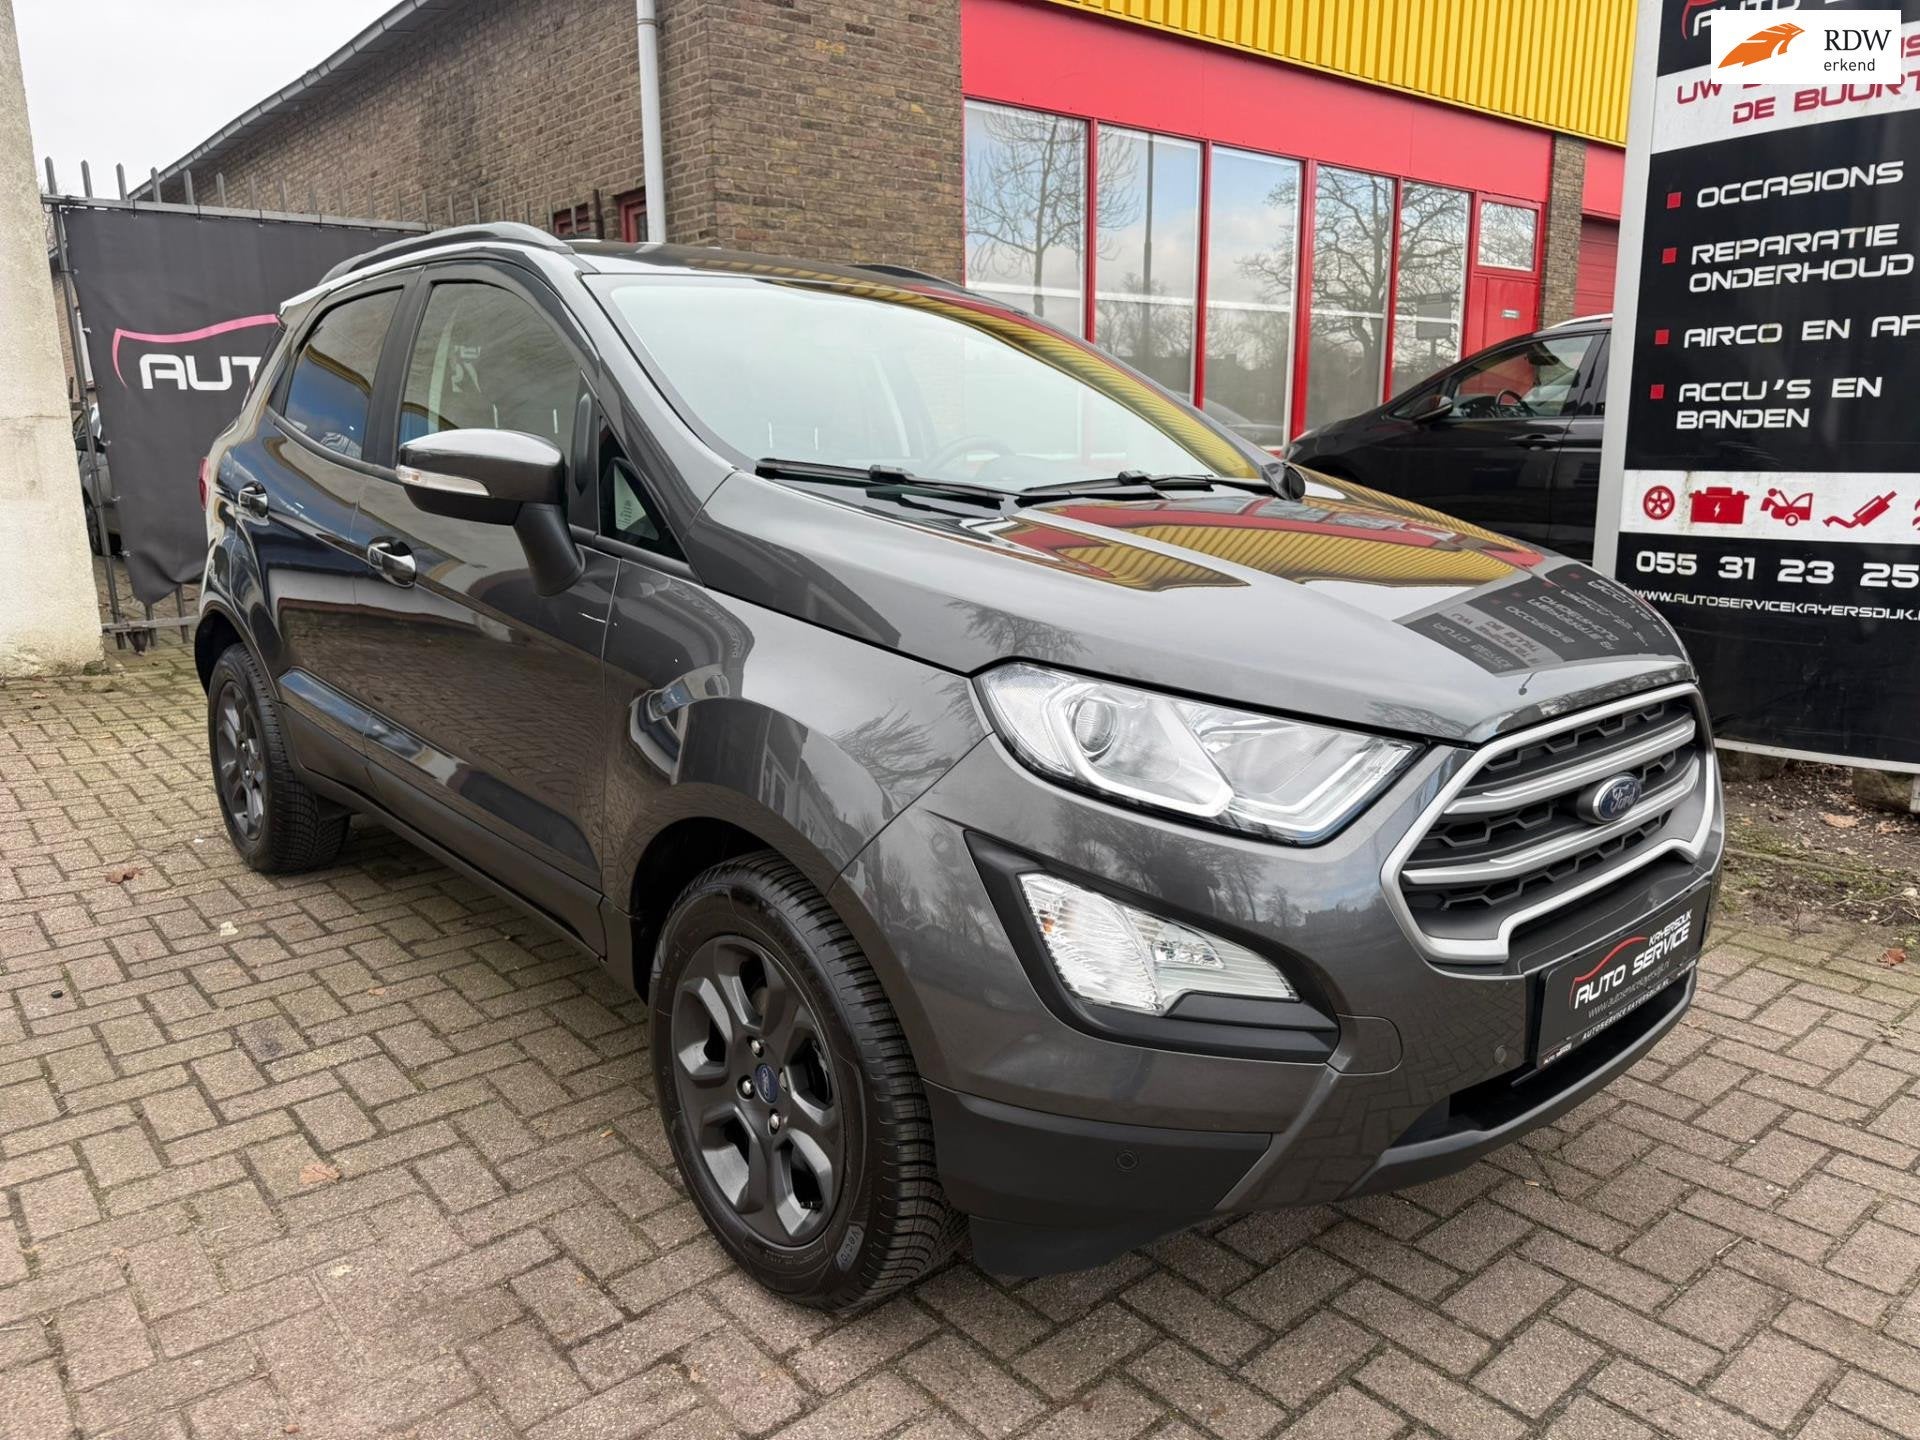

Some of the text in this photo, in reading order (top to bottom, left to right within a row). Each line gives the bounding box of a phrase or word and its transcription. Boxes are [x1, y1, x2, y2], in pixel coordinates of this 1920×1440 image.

[1677, 78, 1722, 104] UW
[1733, 97, 1775, 124] DE
[1696, 161, 1904, 208] OCCASIONS
[1691, 224, 1900, 265] REPARATIE
[1689, 253, 1914, 293] ONDERHOUD
[1683, 323, 1783, 348] AIRCO
[1801, 319, 1851, 341] EN
[1678, 377, 1883, 402] ACCU'S EN
[1676, 408, 1810, 430] BANDEN
[1636, 551, 1920, 588] 055 31 23 25
[1574, 921, 1691, 1009] AUTO SERVICE
